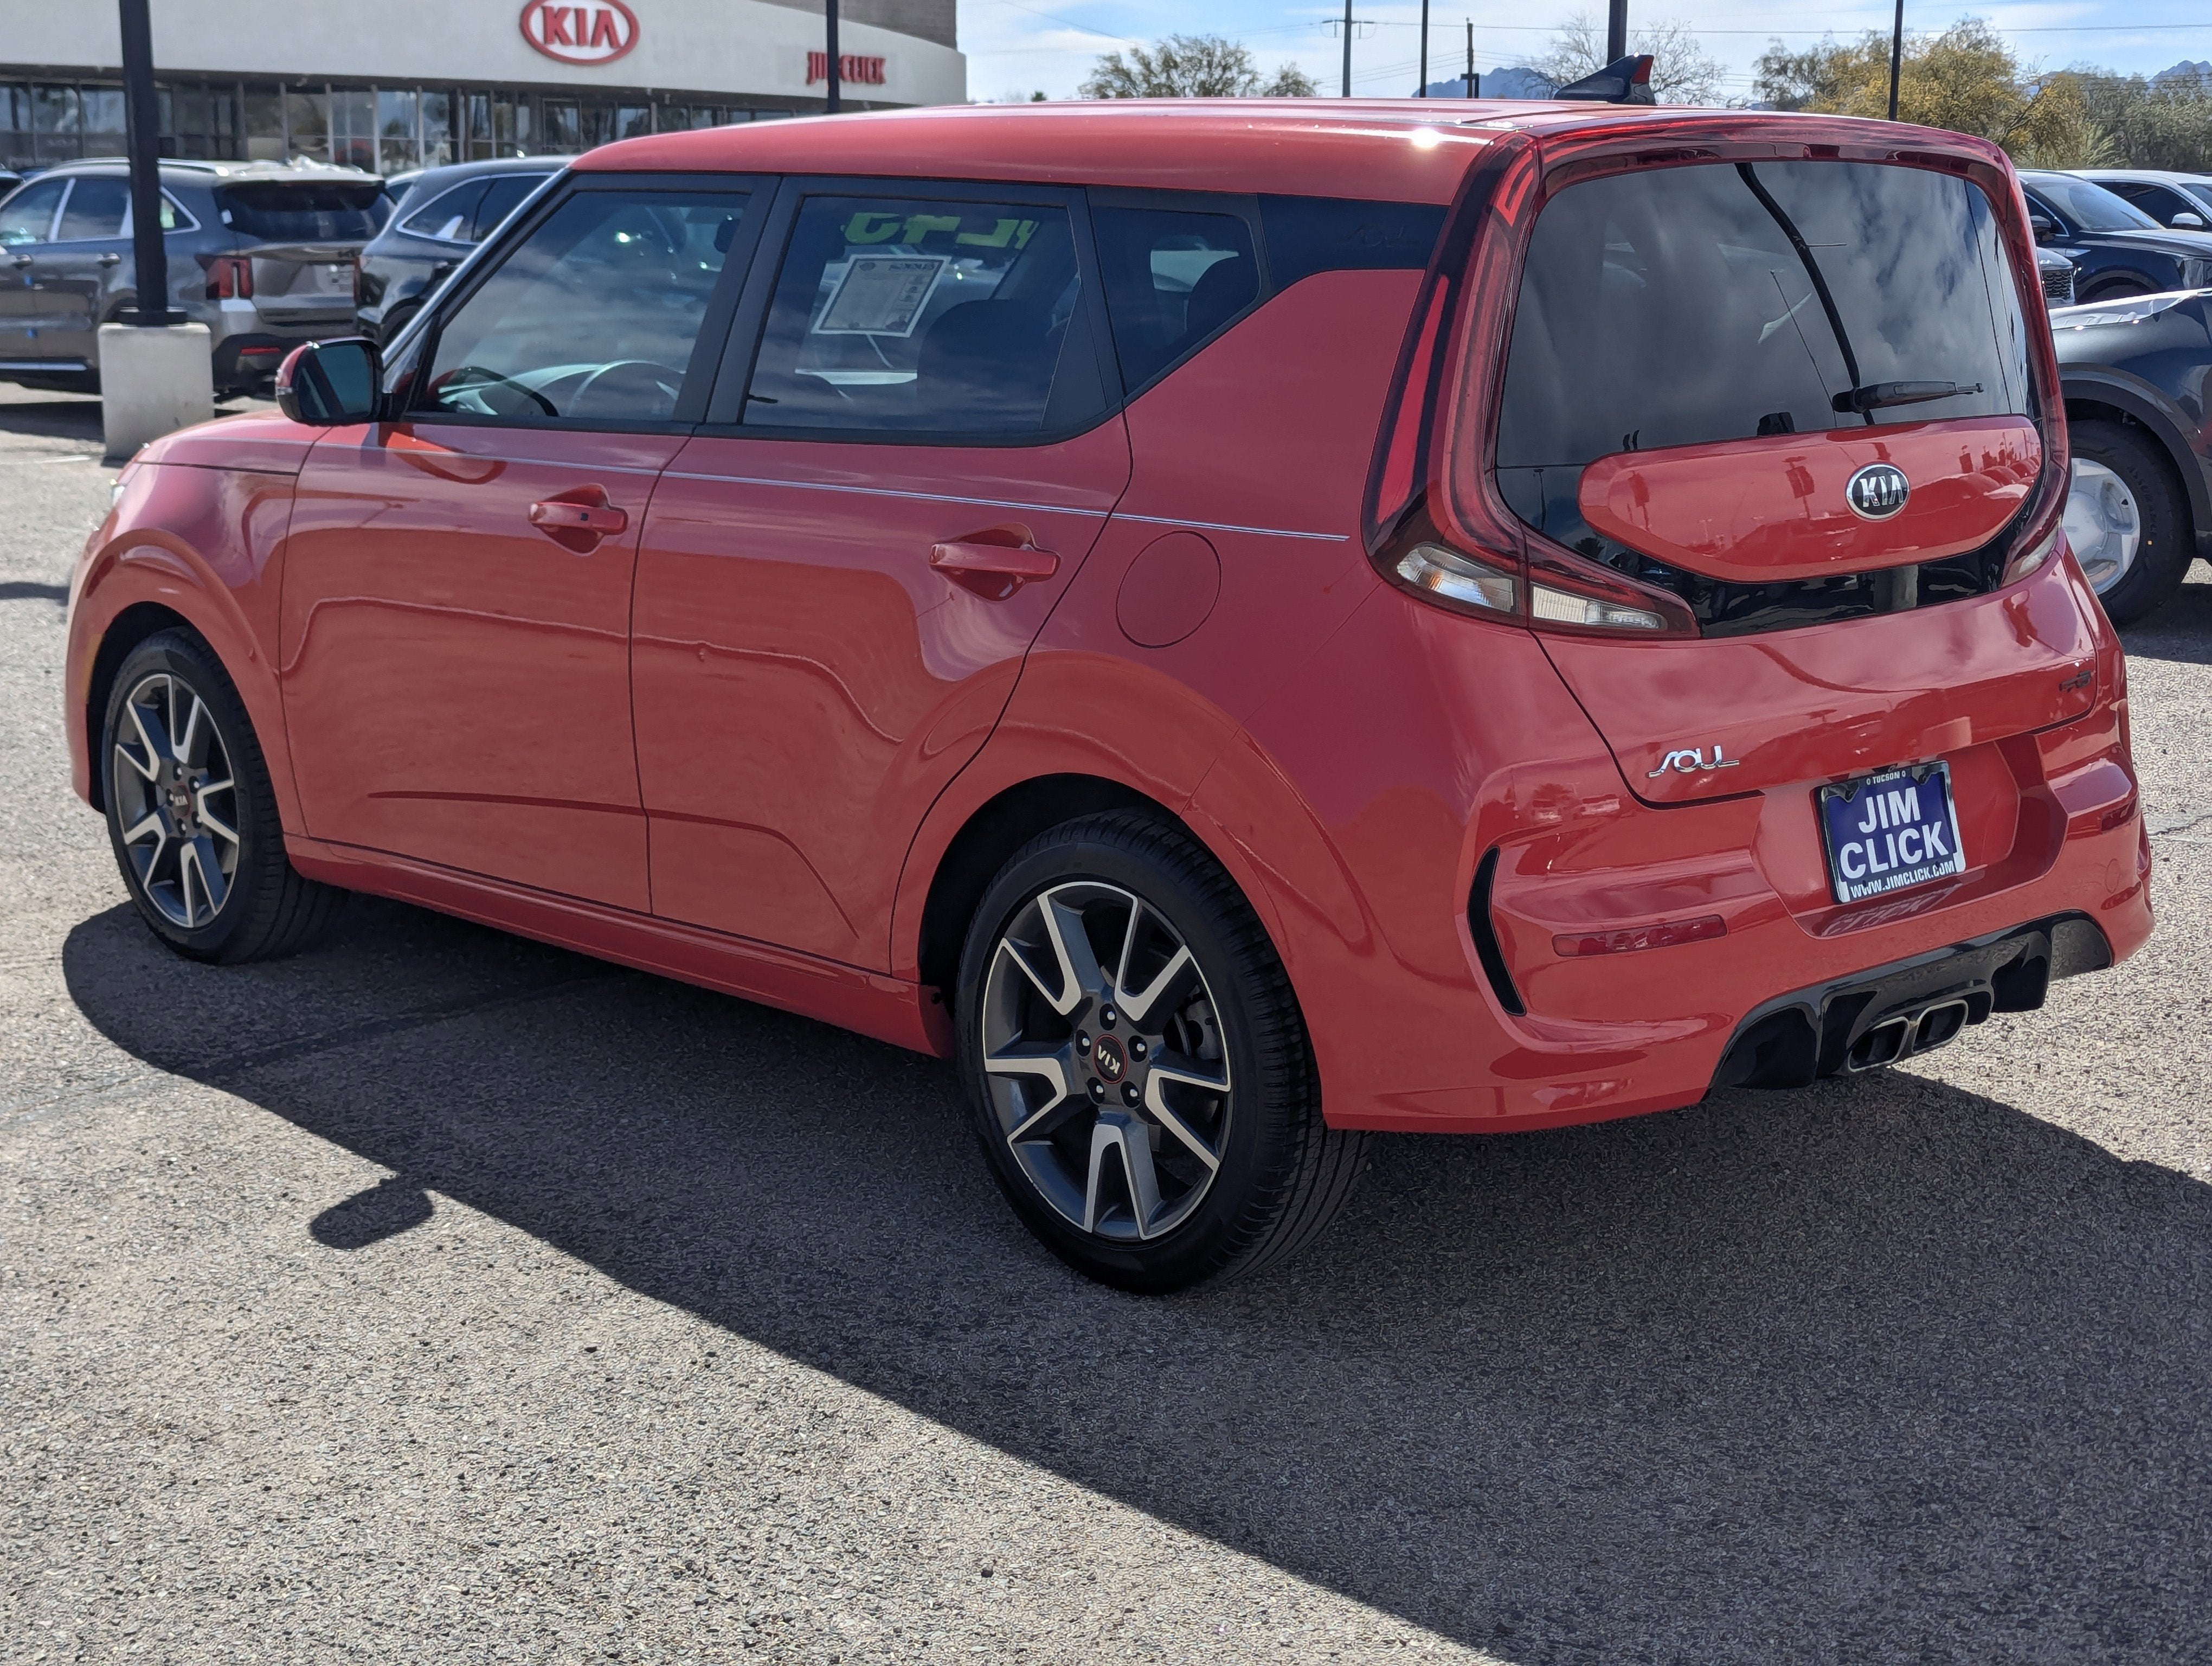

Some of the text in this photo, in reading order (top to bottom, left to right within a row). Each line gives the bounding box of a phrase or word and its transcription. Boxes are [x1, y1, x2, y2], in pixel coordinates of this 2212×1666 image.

[542, 6, 621, 48] KIA
[839, 54, 886, 84] CLICK
[1860, 475, 1904, 507] KIA
[1648, 745, 1740, 778] SOUL
[1873, 771, 1900, 784] TUCSON
[1859, 787, 1921, 833] JIM
[1840, 821, 1951, 879] CLICK
[1850, 860, 1955, 899] WWW.JIMCLICK.COM
[1098, 1045, 1121, 1075] KIA
